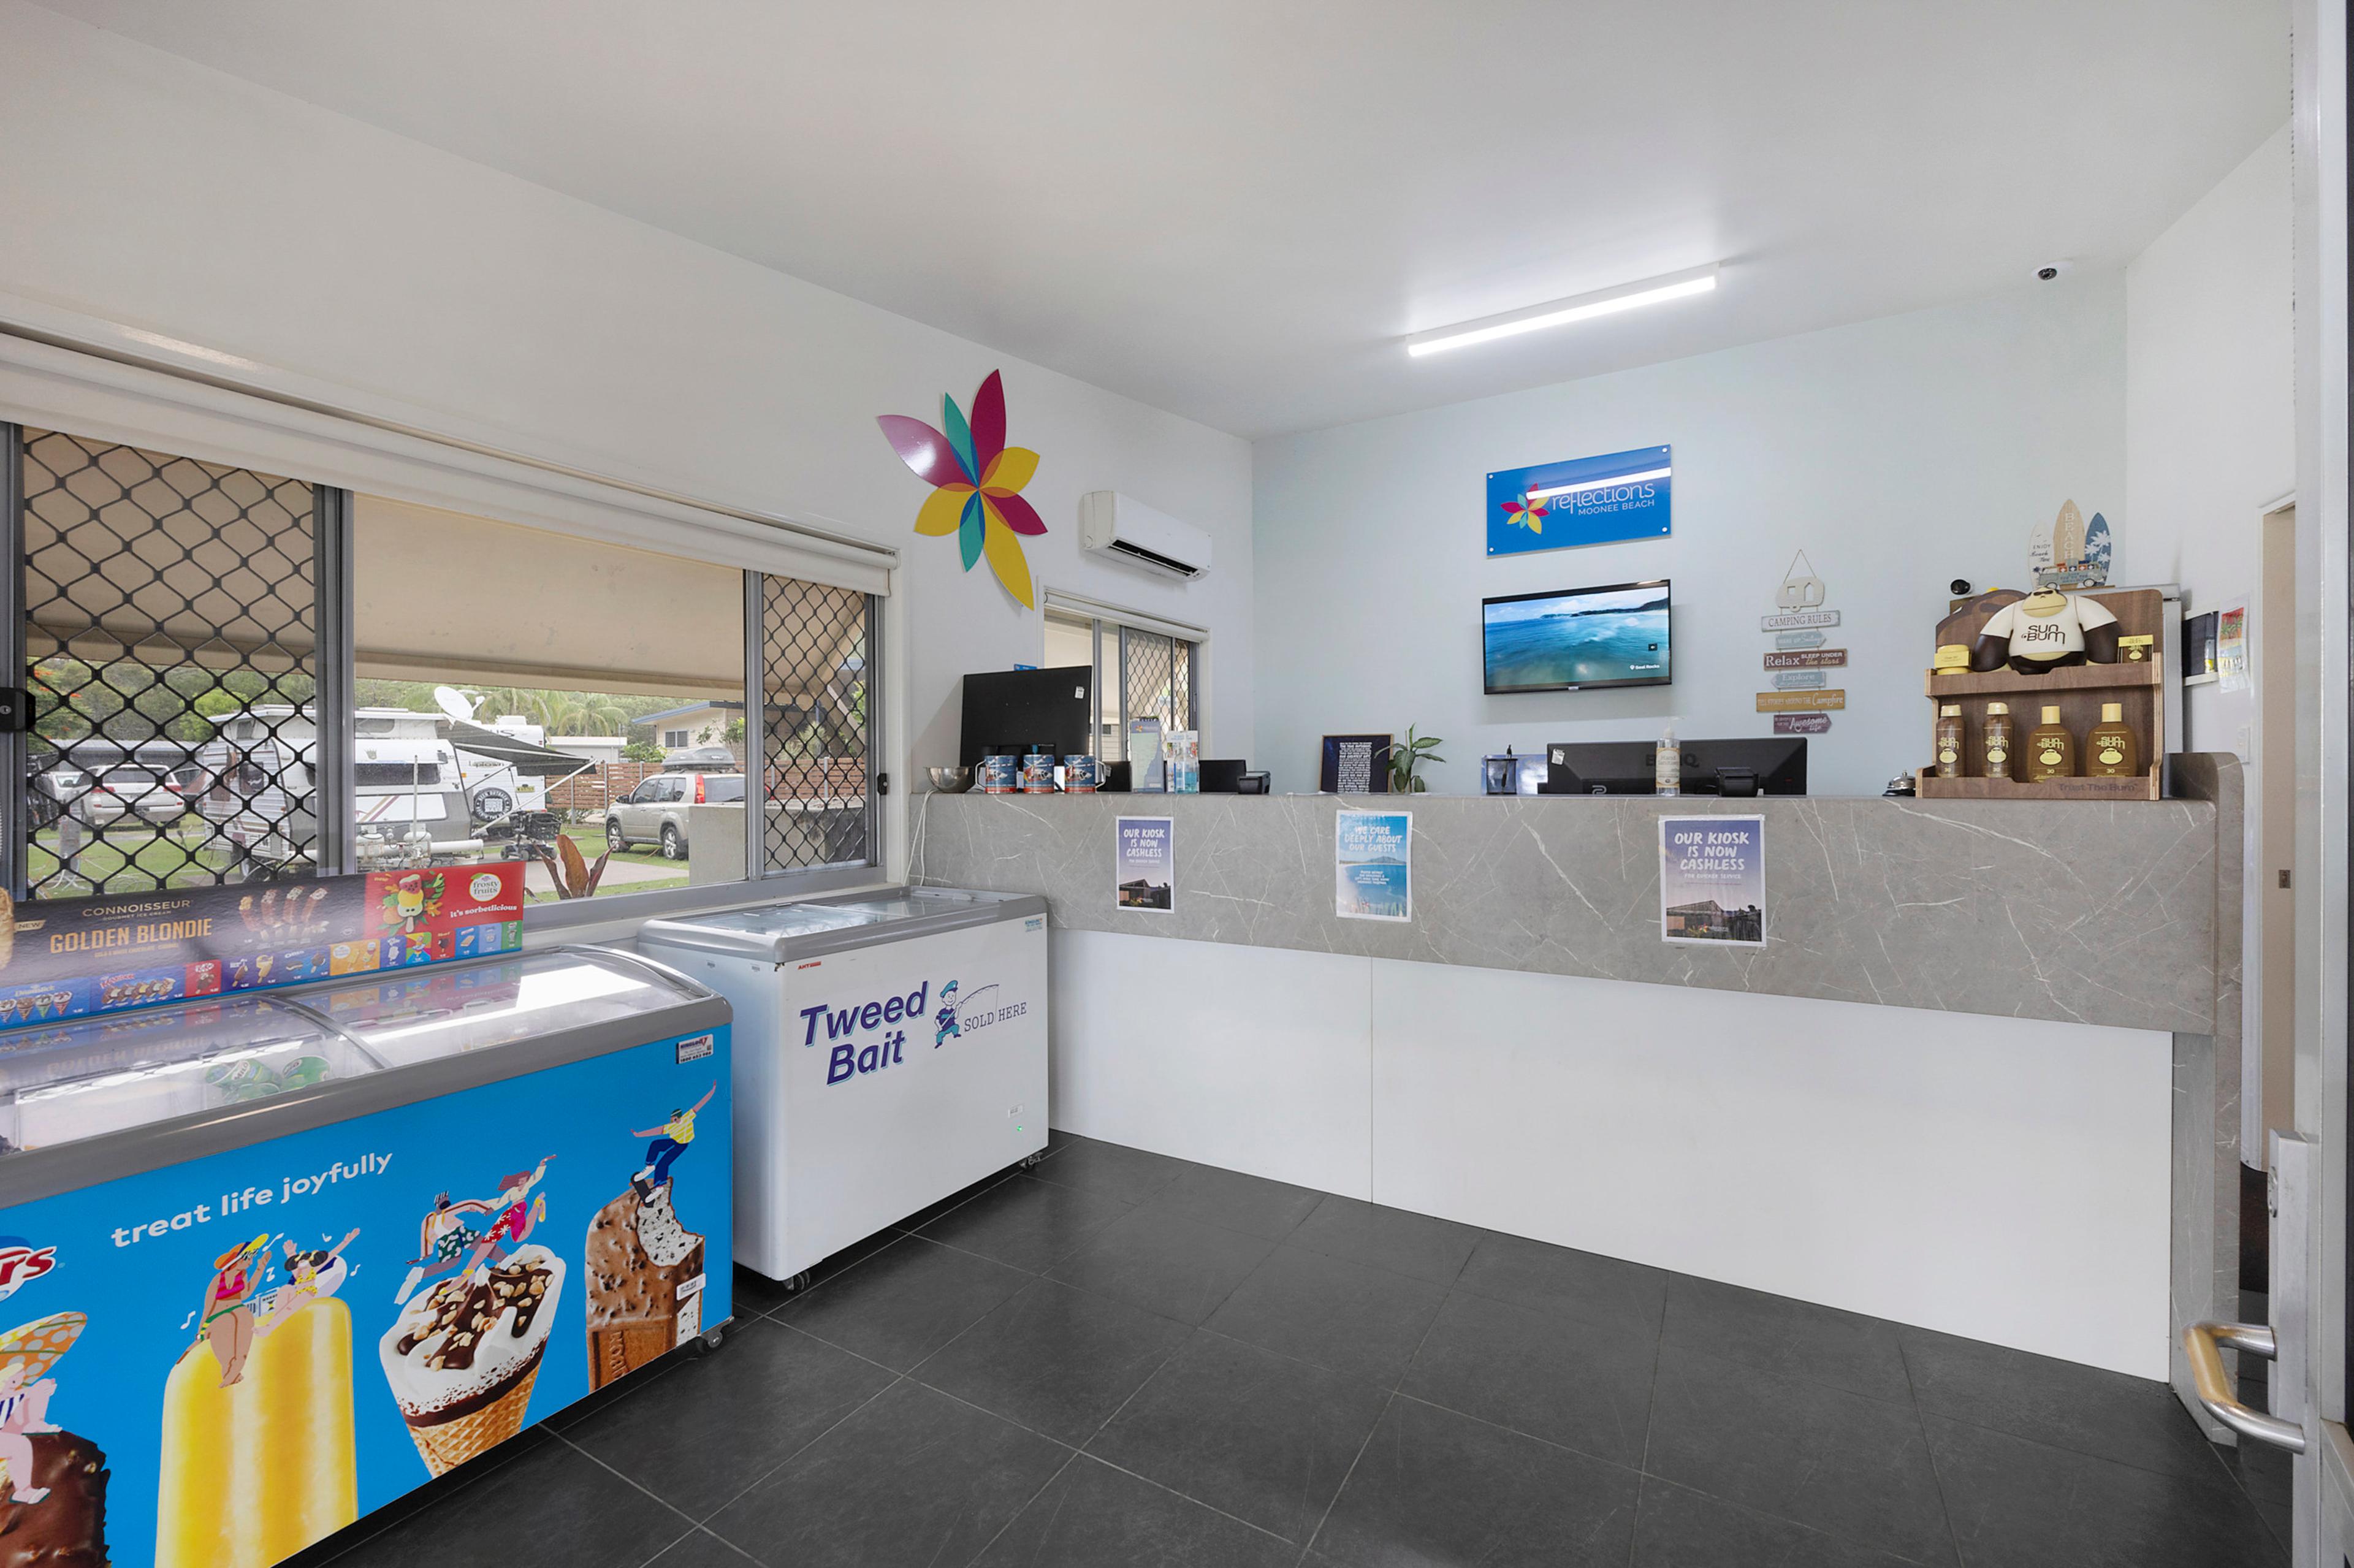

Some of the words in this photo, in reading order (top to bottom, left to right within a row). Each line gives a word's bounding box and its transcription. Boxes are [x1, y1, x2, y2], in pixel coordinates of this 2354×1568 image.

[1552, 482, 1655, 514] reflections
[1579, 504, 1619, 516] MOONEE
[1622, 500, 1655, 511] BEACH
[1769, 616, 1805, 627] CAMPING
[1808, 613, 1832, 623] RULES
[1766, 655, 1800, 667] Relax
[1782, 674, 1815, 682] Explore
[1124, 829, 1140, 838] OUR
[1142, 829, 1165, 838] KIOSK
[1370, 826, 1390, 835] CARE
[1130, 839, 1137, 847] IS
[1140, 839, 1158, 848] NOW
[1344, 834, 1374, 843] DEEPLY
[1674, 832, 1703, 845] OUR
[1708, 832, 1749, 845] KIOSK
[1127, 848, 1162, 858] CASHLESS
[1368, 844, 1396, 853] GUESTS
[1688, 846, 1699, 857] IS
[1705, 846, 1737, 858] NOW
[1680, 858, 1745, 870] CASHLESS
[473, 881, 499, 889] frosty
[82, 899, 191, 918] CONNOISSEUR
[451, 908, 464, 918] it's
[465, 904, 517, 915] sorbetlicious
[50, 926, 129, 954] GOLDEN
[137, 918, 213, 945] BLONDIE
[800, 980, 929, 1047] Tweed
[964, 1011, 994, 1032] SOLD
[999, 1002, 1027, 1022] HERE
[826, 1030, 907, 1086] Bait
[110, 1203, 211, 1248] treat
[222, 1187, 272, 1216] life
[281, 1153, 392, 1203] joyfully
